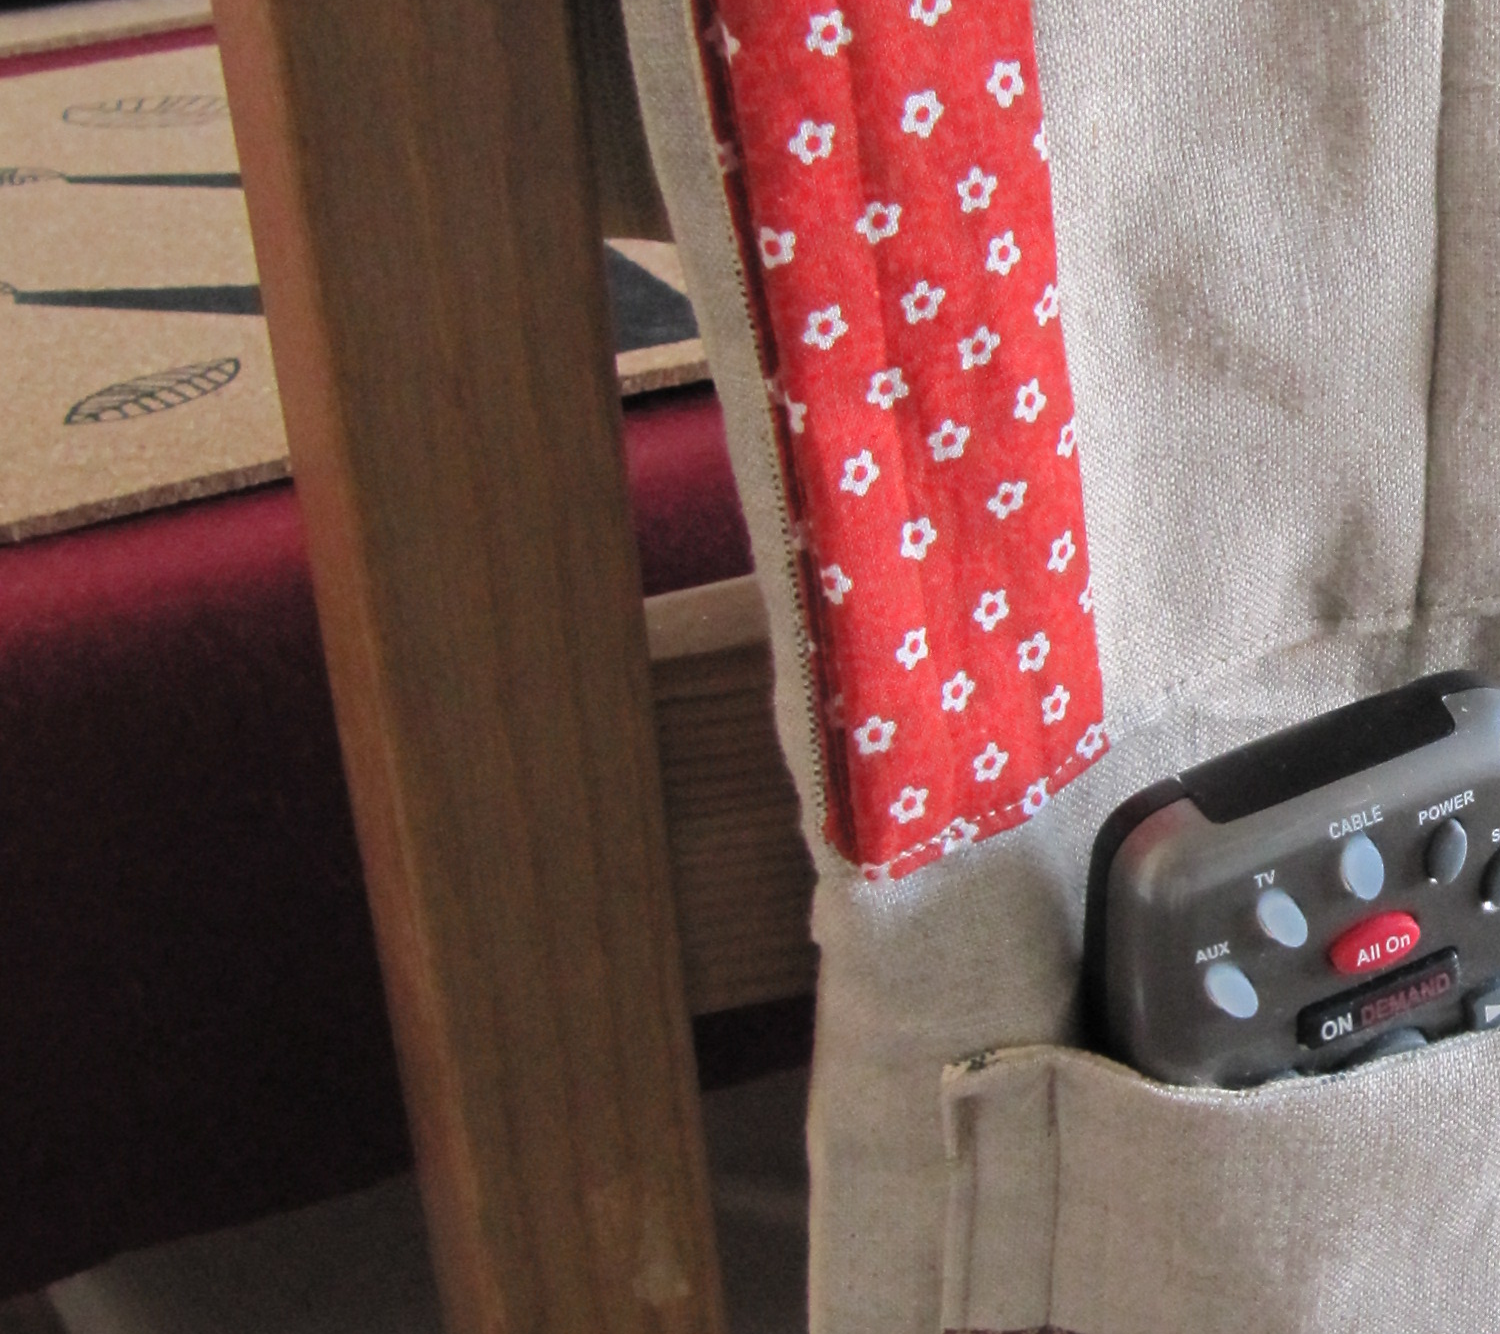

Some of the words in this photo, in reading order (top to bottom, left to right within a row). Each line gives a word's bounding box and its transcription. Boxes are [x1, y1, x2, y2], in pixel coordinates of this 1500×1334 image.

[1329, 805, 1384, 840] CABLE
[1418, 789, 1475, 825] POWER
[1253, 869, 1276, 889] TV
[1195, 940, 1230, 964] AUX
[1356, 941, 1381, 968] All
[1386, 933, 1412, 955] On
[1321, 1012, 1354, 1042] ON
[1360, 971, 1451, 1027] DEMAND
